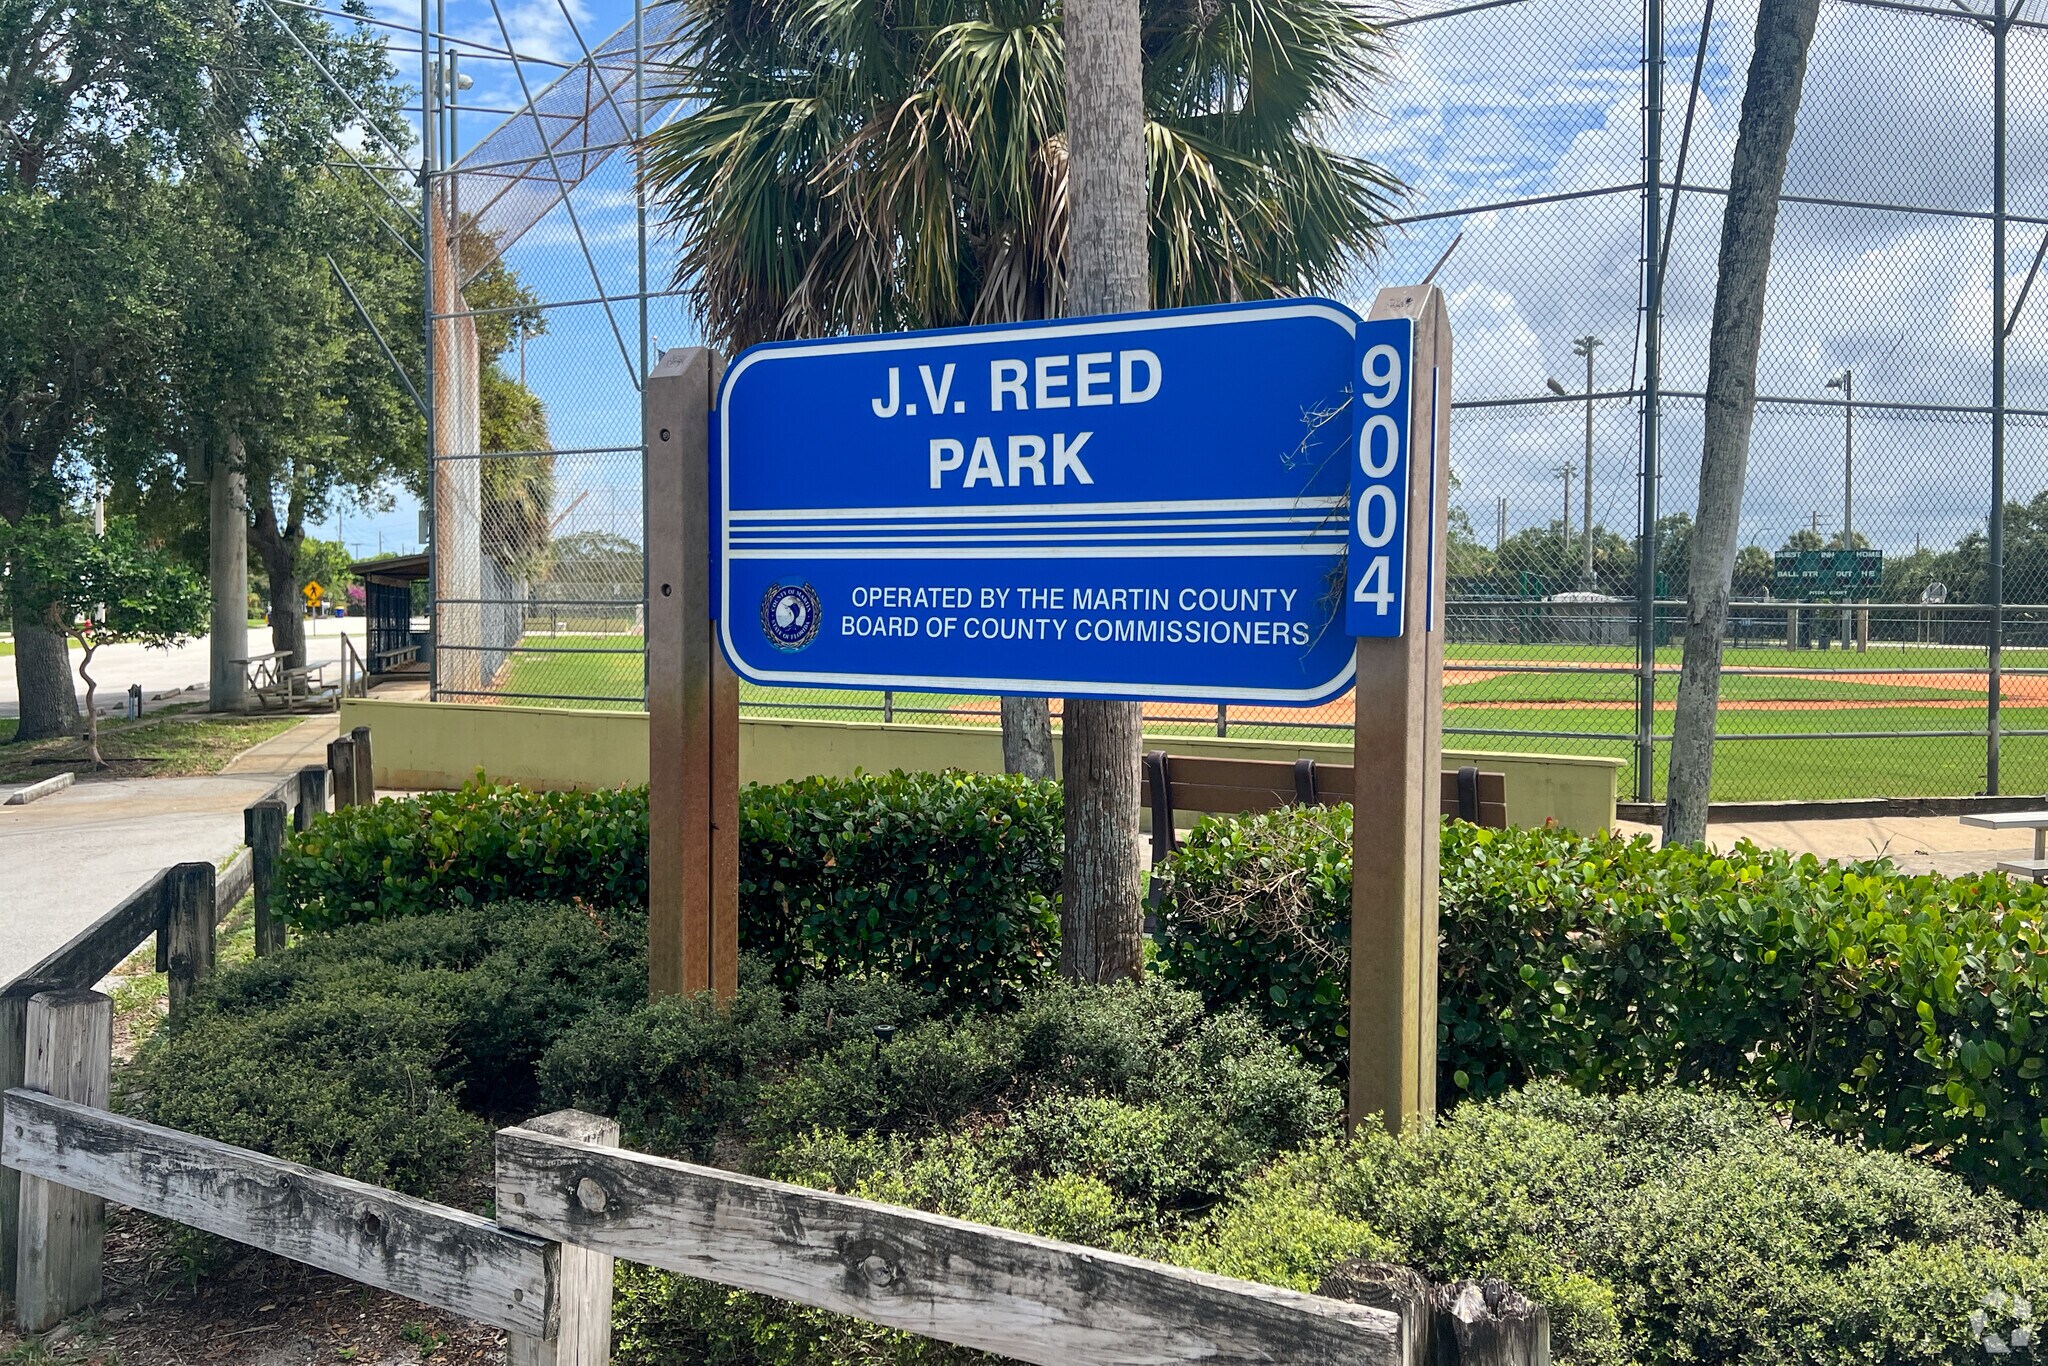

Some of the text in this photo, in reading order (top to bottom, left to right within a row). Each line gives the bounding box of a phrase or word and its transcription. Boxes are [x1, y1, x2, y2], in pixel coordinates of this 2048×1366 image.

[871, 349, 1162, 418] J.V. REED
[929, 431, 1095, 489] PARK
[1353, 344, 1401, 616] 9004
[852, 586, 1297, 612] OPERATED BY THE MARTIN COUNTY
[841, 615, 1309, 645] BOARD OF COUNTY COMMISSIONERS
